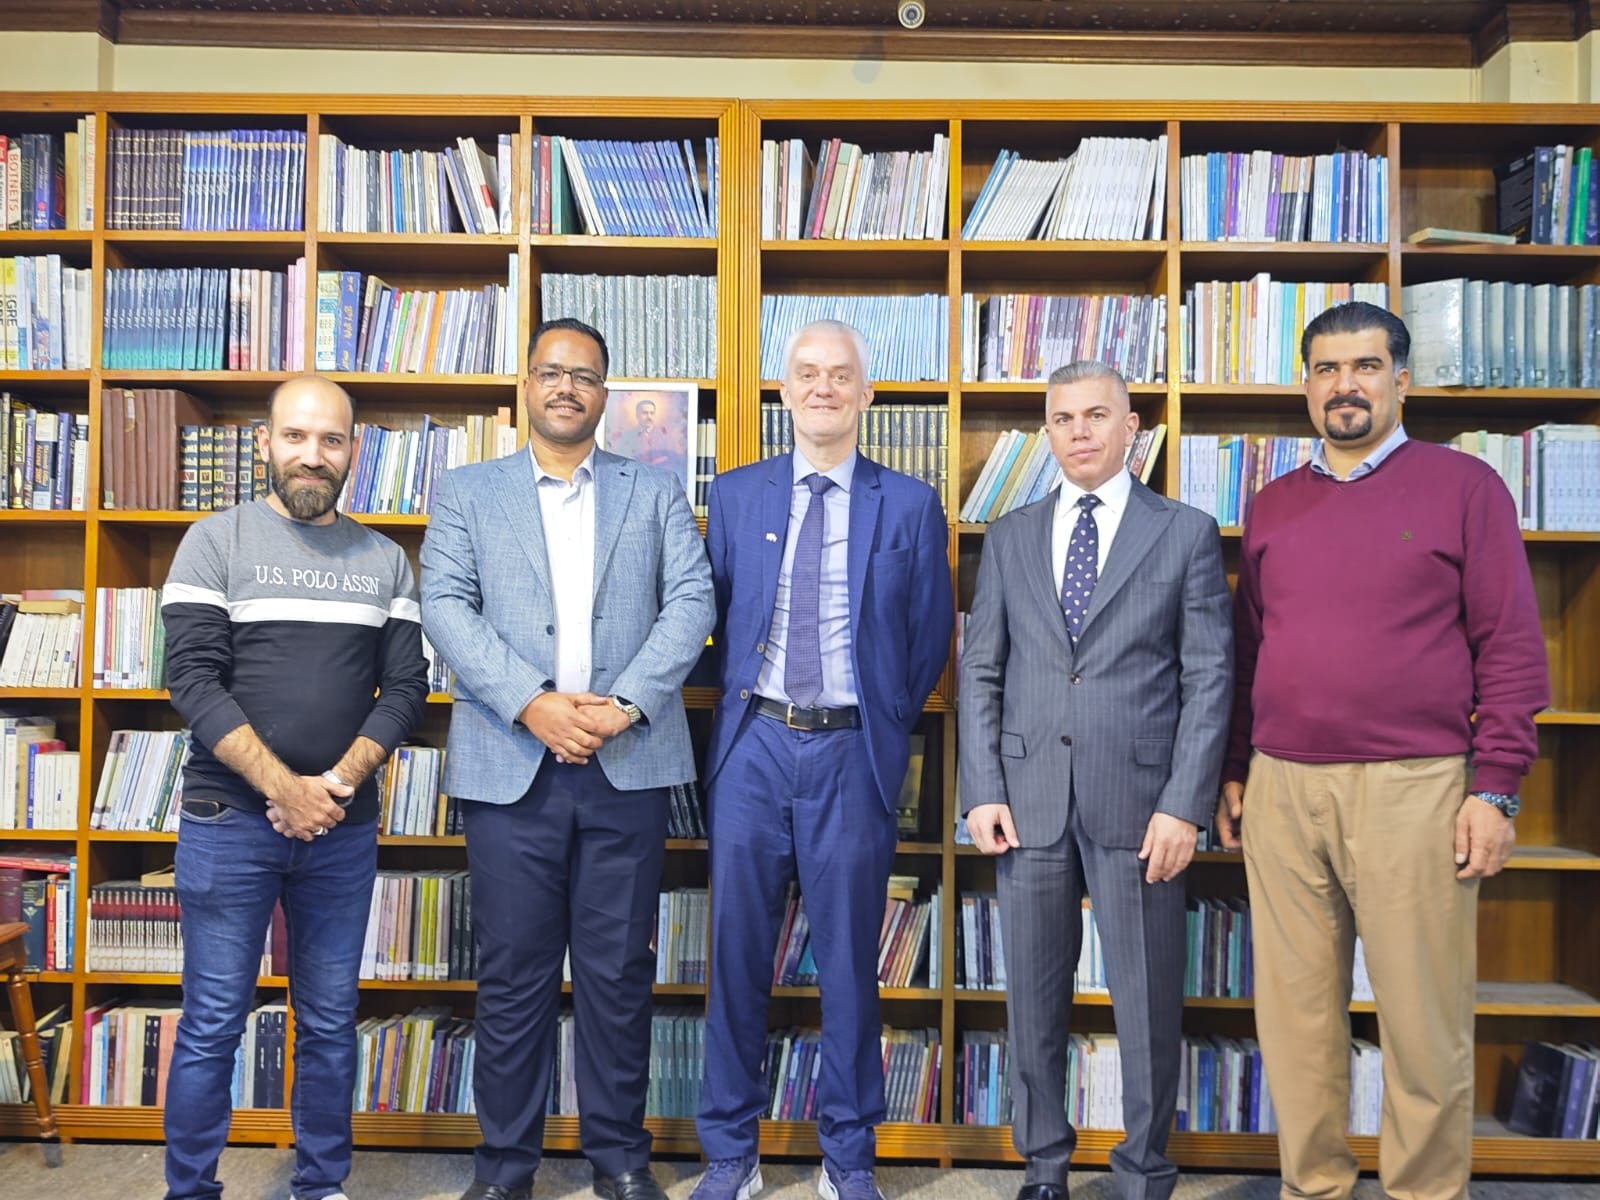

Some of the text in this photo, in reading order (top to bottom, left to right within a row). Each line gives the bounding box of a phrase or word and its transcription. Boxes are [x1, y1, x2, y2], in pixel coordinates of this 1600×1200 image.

[9, 153, 19, 211] BOTNETS
[6, 299, 18, 327] GRE
[255, 565, 380, 596] U.S. POLO ASSN
